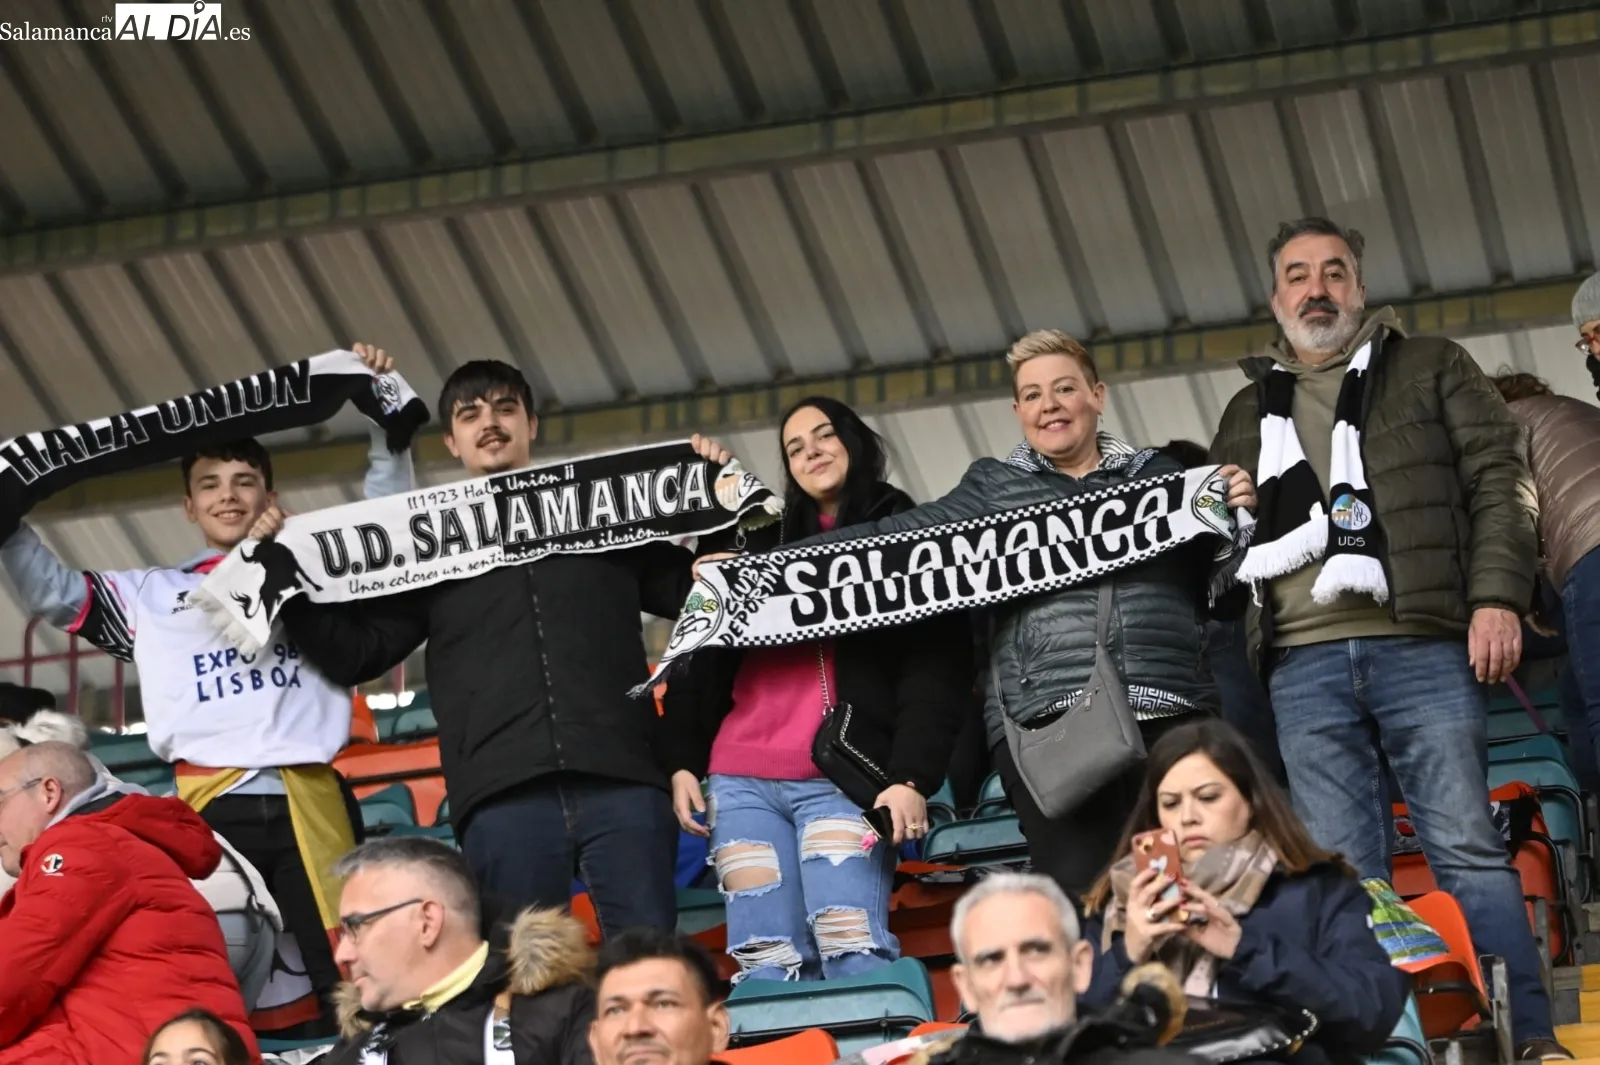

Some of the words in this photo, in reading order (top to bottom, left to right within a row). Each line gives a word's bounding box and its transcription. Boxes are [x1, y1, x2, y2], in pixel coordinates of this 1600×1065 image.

[1, 412, 150, 485] HALA
[155, 359, 312, 434] UNION
[464, 481, 503, 499] Hala
[311, 522, 406, 578] U.D.
[409, 462, 714, 564] SALAMANCA
[1338, 536, 1365, 547] UDS
[349, 580, 385, 594] Unos
[389, 570, 439, 587] colores
[442, 565, 463, 576] un
[466, 541, 562, 570] sentimiento
[564, 540, 596, 550] una
[784, 487, 1173, 627] SALAMANCA
[718, 551, 786, 646] DEPORTIVO
[725, 567, 759, 616] CLUB
[196, 666, 301, 702] LISBOA
